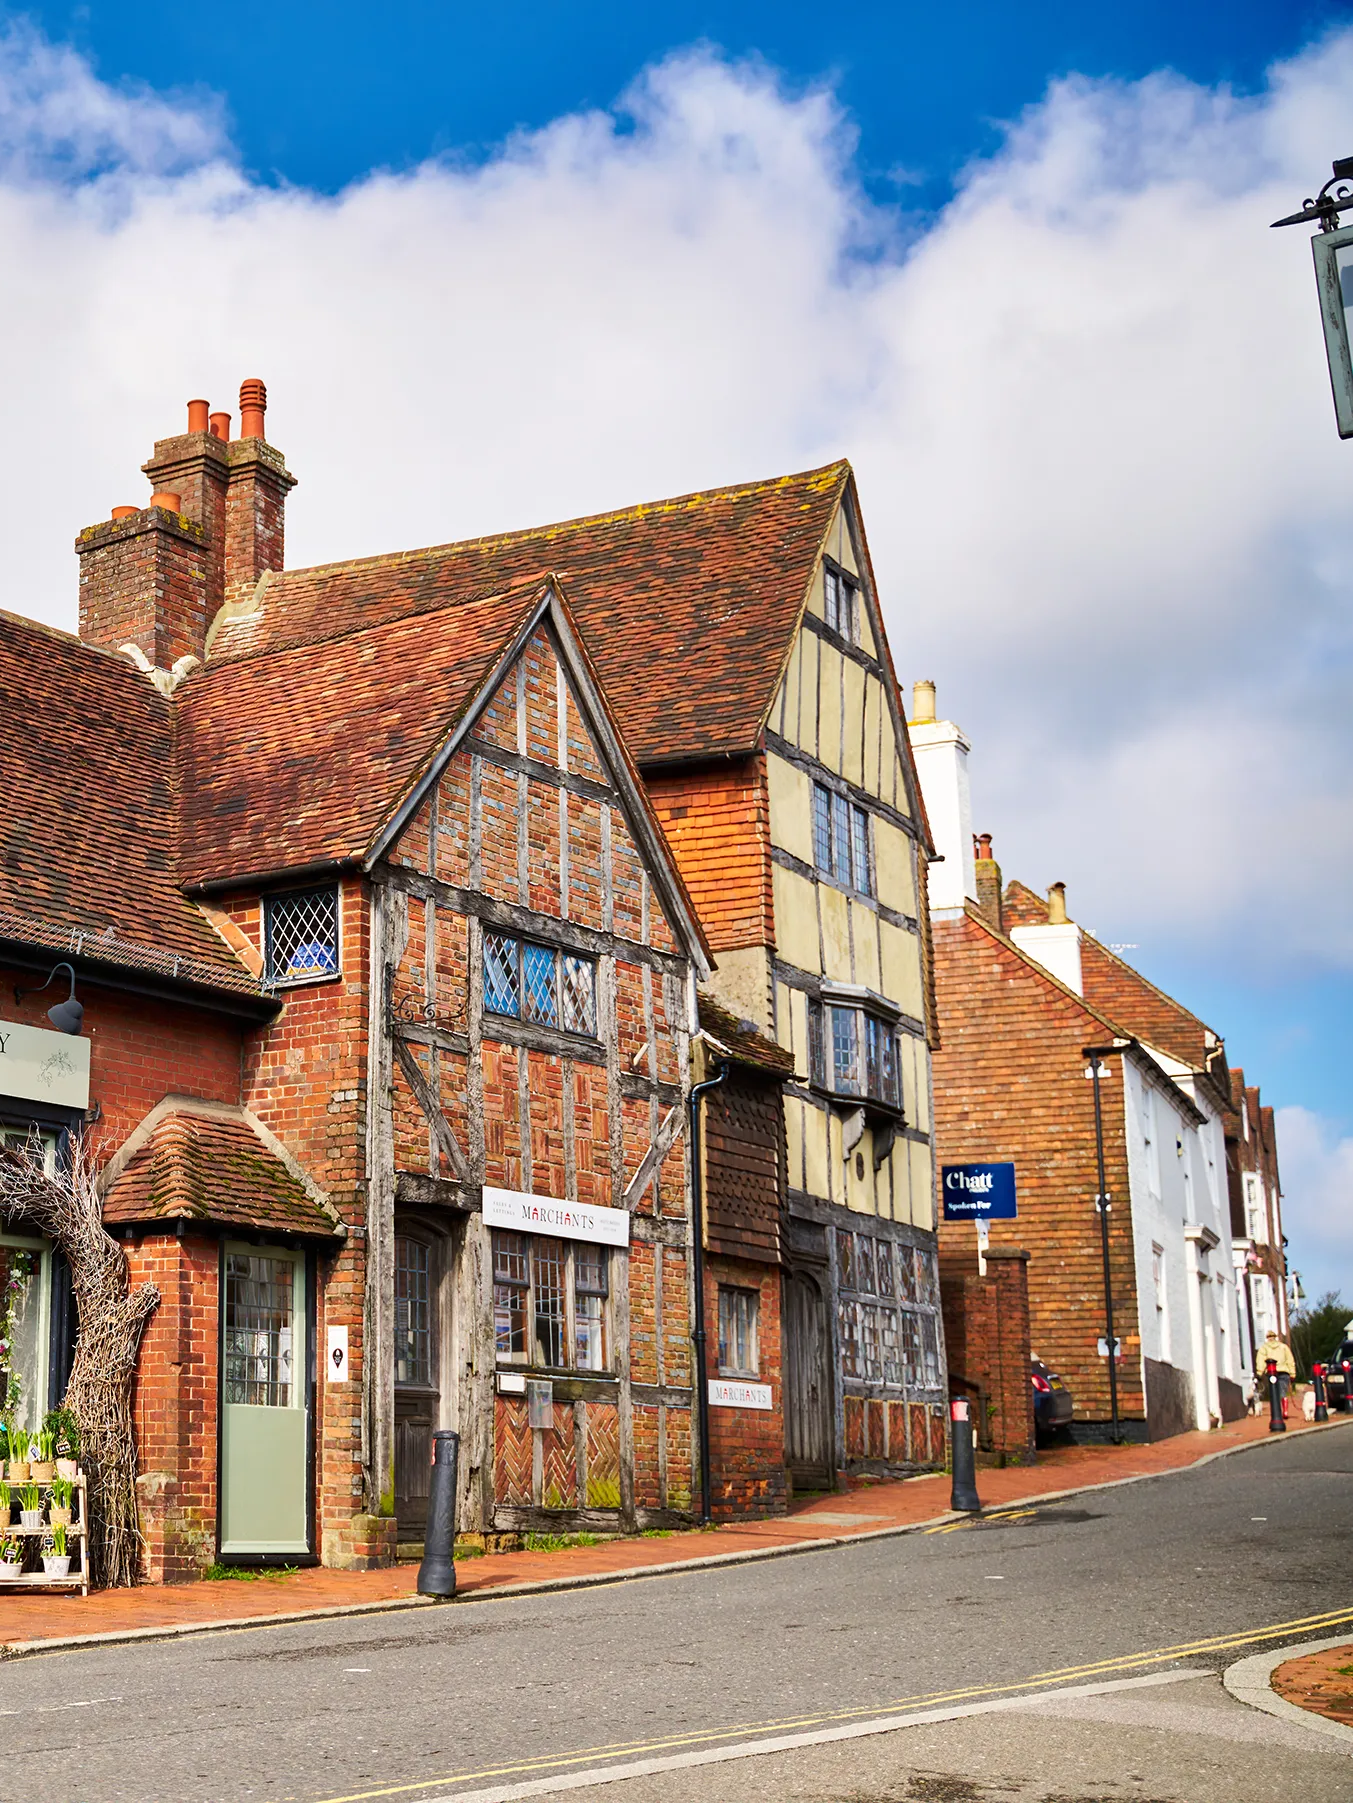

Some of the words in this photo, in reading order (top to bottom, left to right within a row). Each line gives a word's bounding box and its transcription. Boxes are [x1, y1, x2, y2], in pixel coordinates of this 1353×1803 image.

[946, 1171, 994, 1190] Chatt
[521, 1204, 595, 1230] MARCHANTS
[715, 1386, 768, 1403] MARCHANTS
